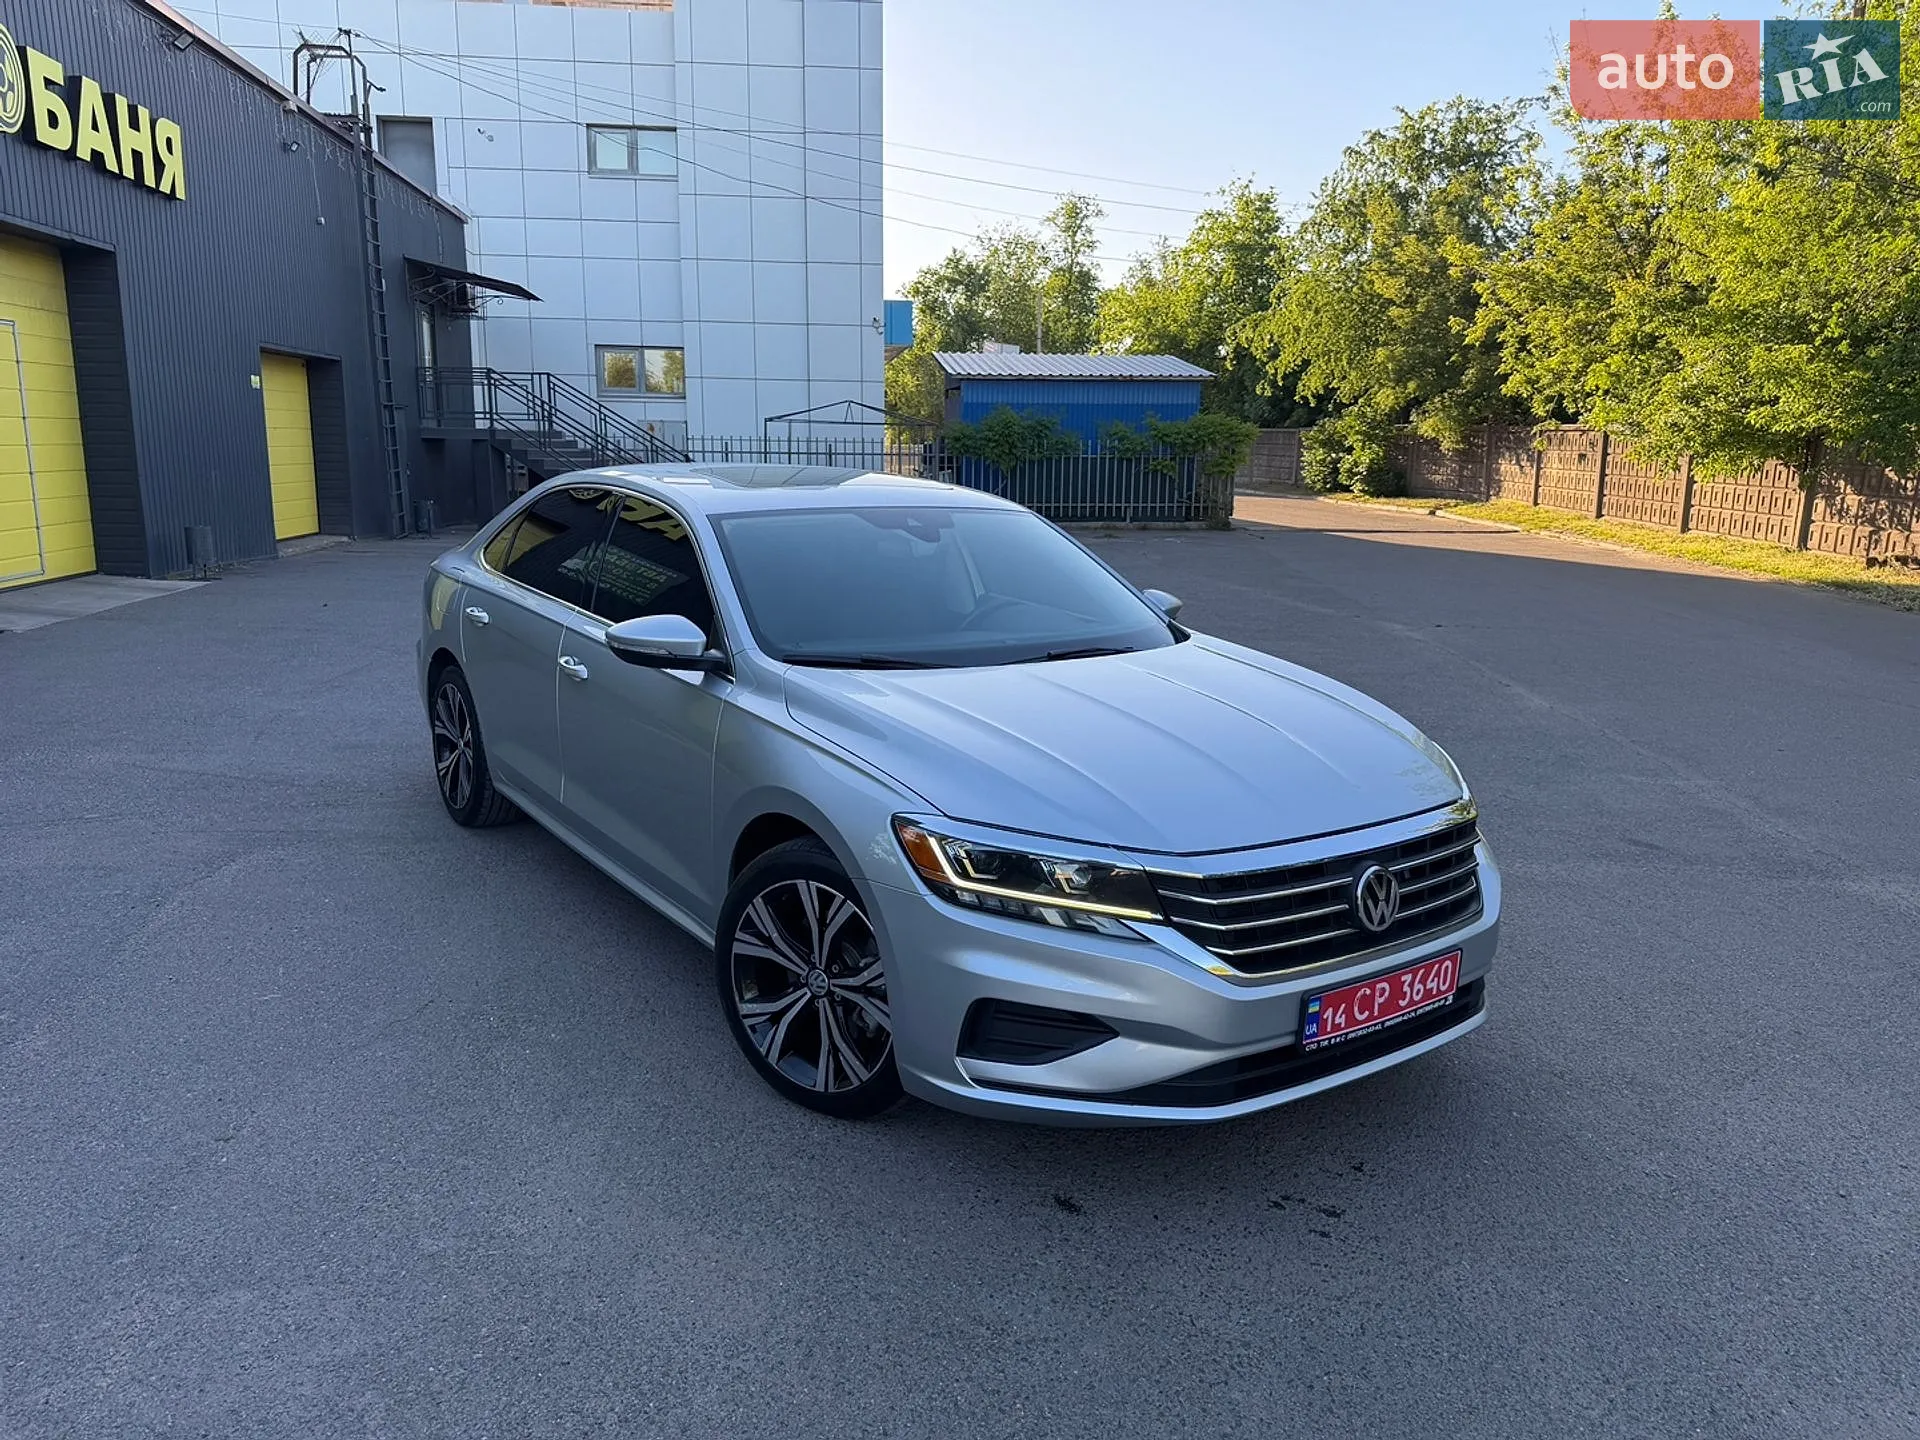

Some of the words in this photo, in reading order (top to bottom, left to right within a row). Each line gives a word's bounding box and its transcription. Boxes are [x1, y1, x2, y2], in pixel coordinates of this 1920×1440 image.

[1323, 1003, 1346, 1032] 14
[1398, 960, 1453, 1007] 3640
[1305, 1023, 1317, 1035] UA
